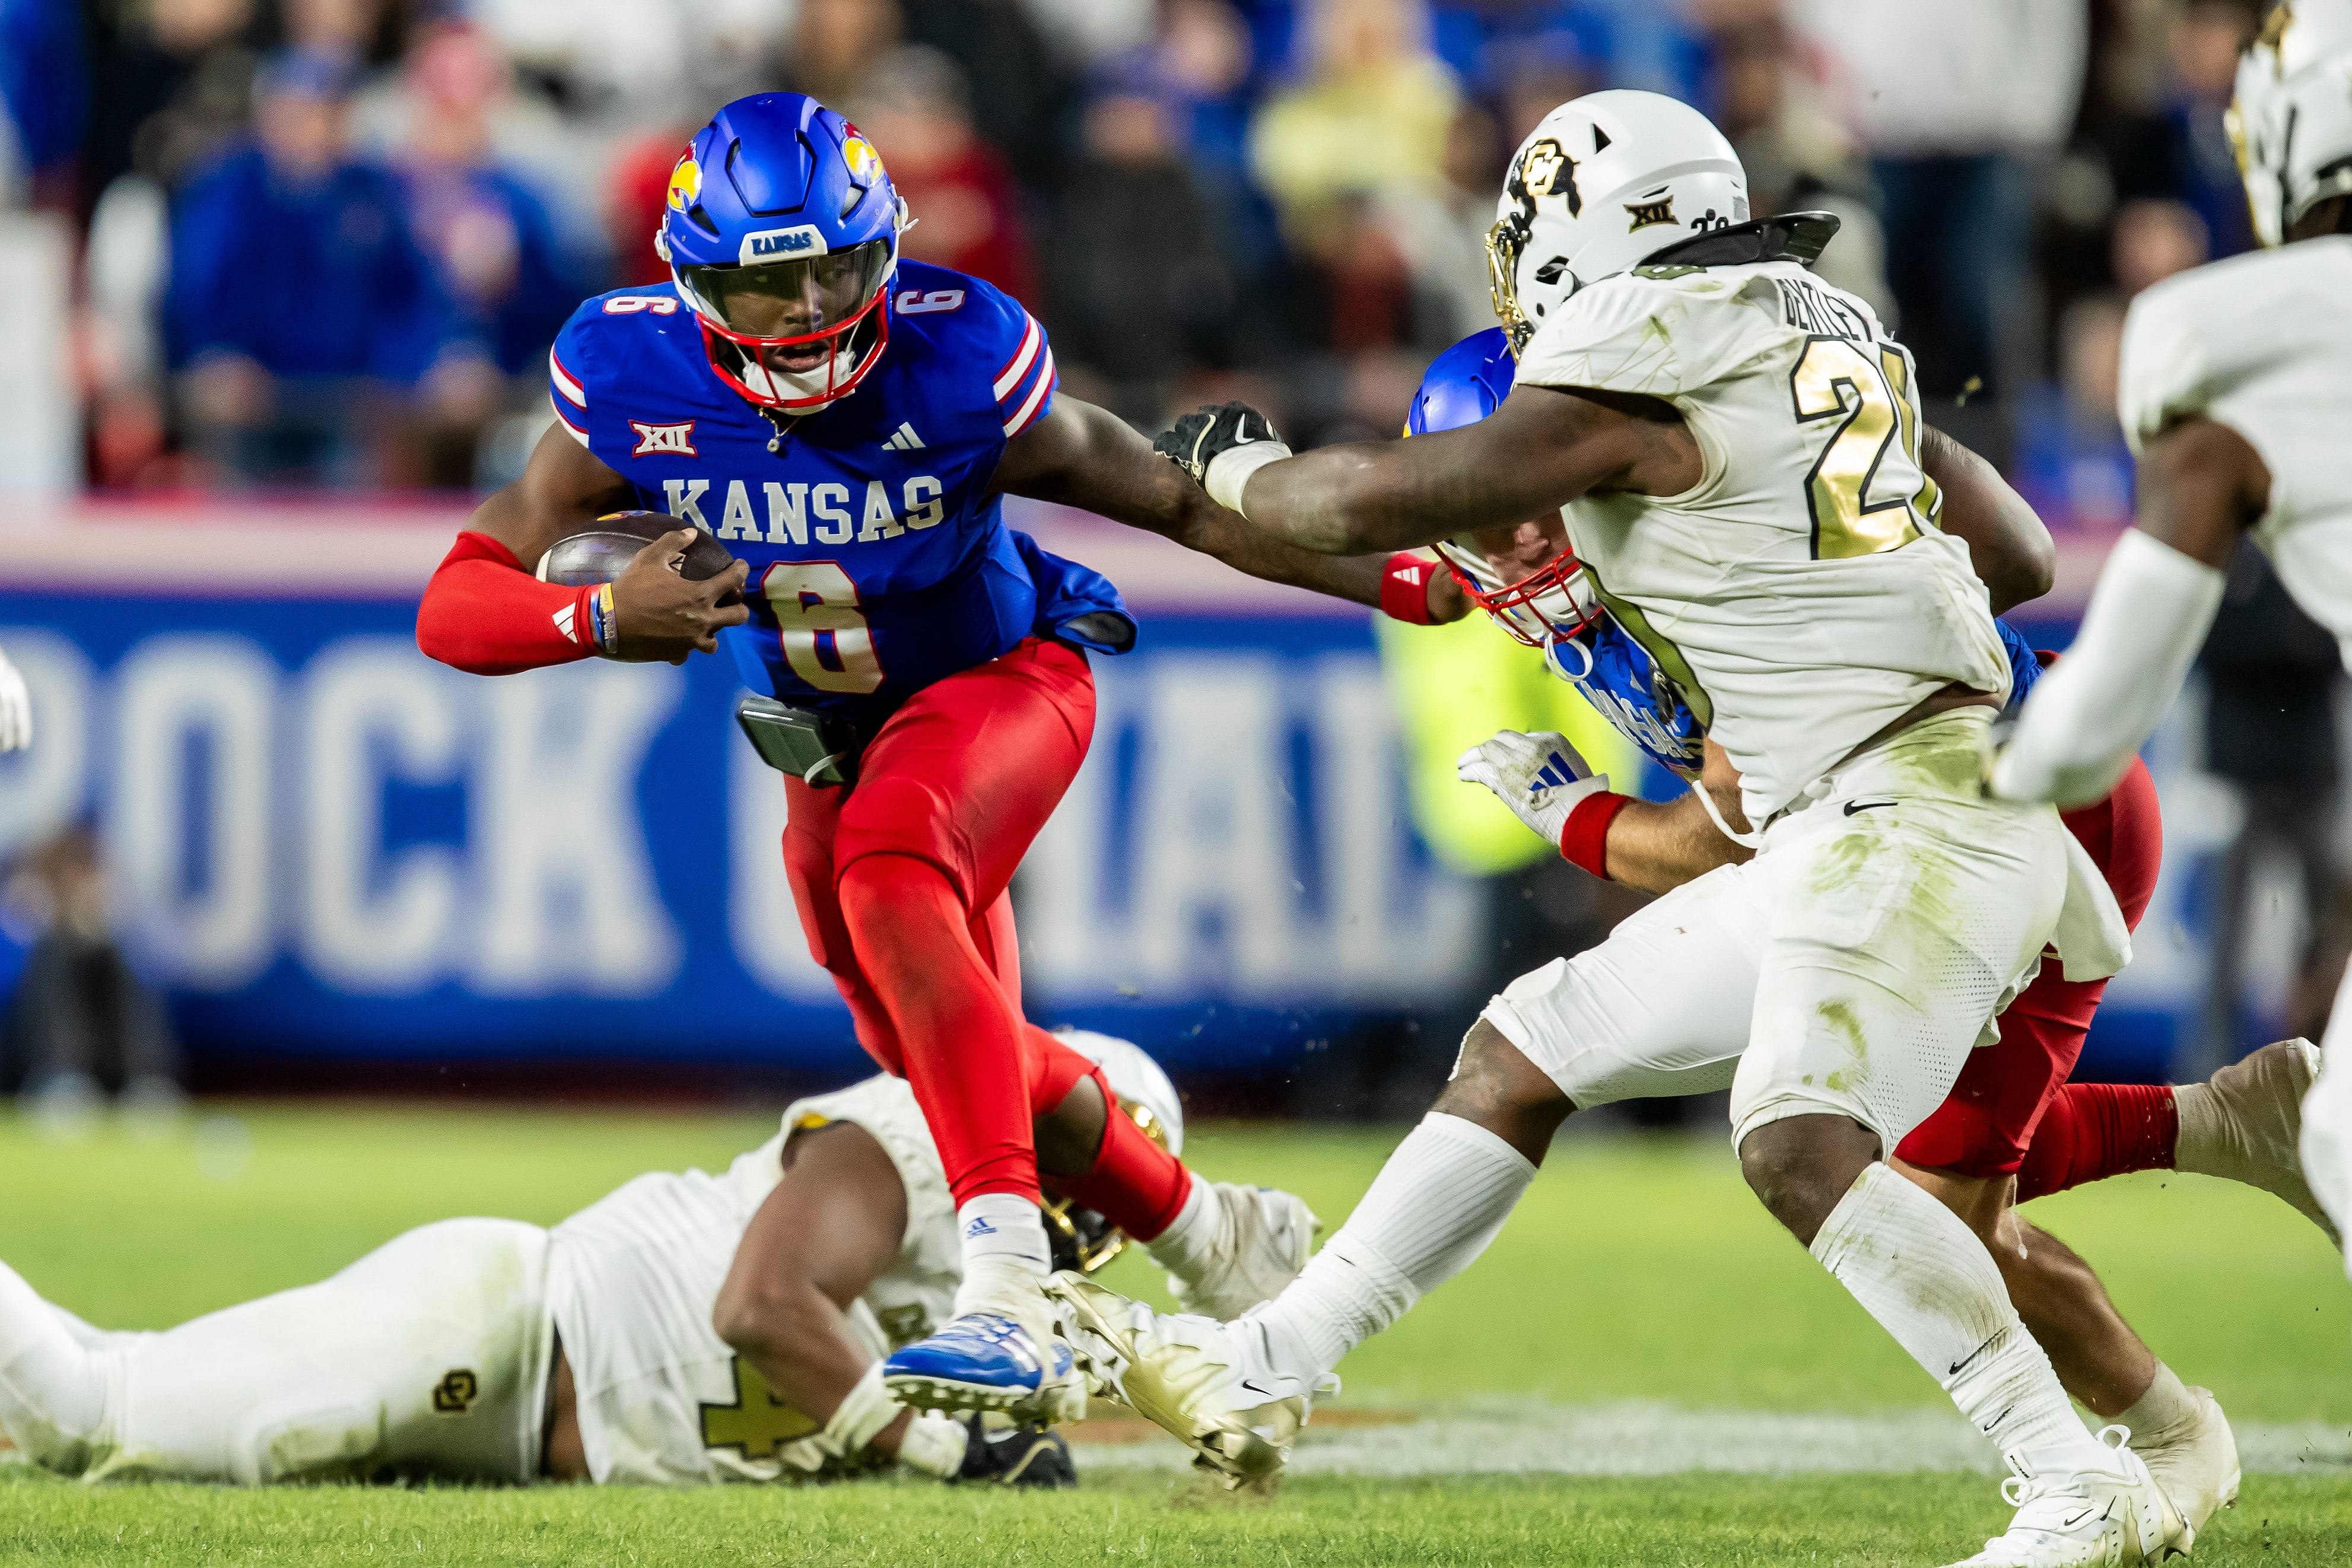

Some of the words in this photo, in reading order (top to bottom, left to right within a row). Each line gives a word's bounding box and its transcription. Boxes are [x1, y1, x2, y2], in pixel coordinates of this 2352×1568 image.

[751, 231, 813, 256] KANSAS
[602, 295, 679, 316] 6
[895, 288, 967, 314] 6
[630, 421, 696, 456] XII
[662, 475, 945, 545] KANSAS
[759, 559, 887, 695] 6
